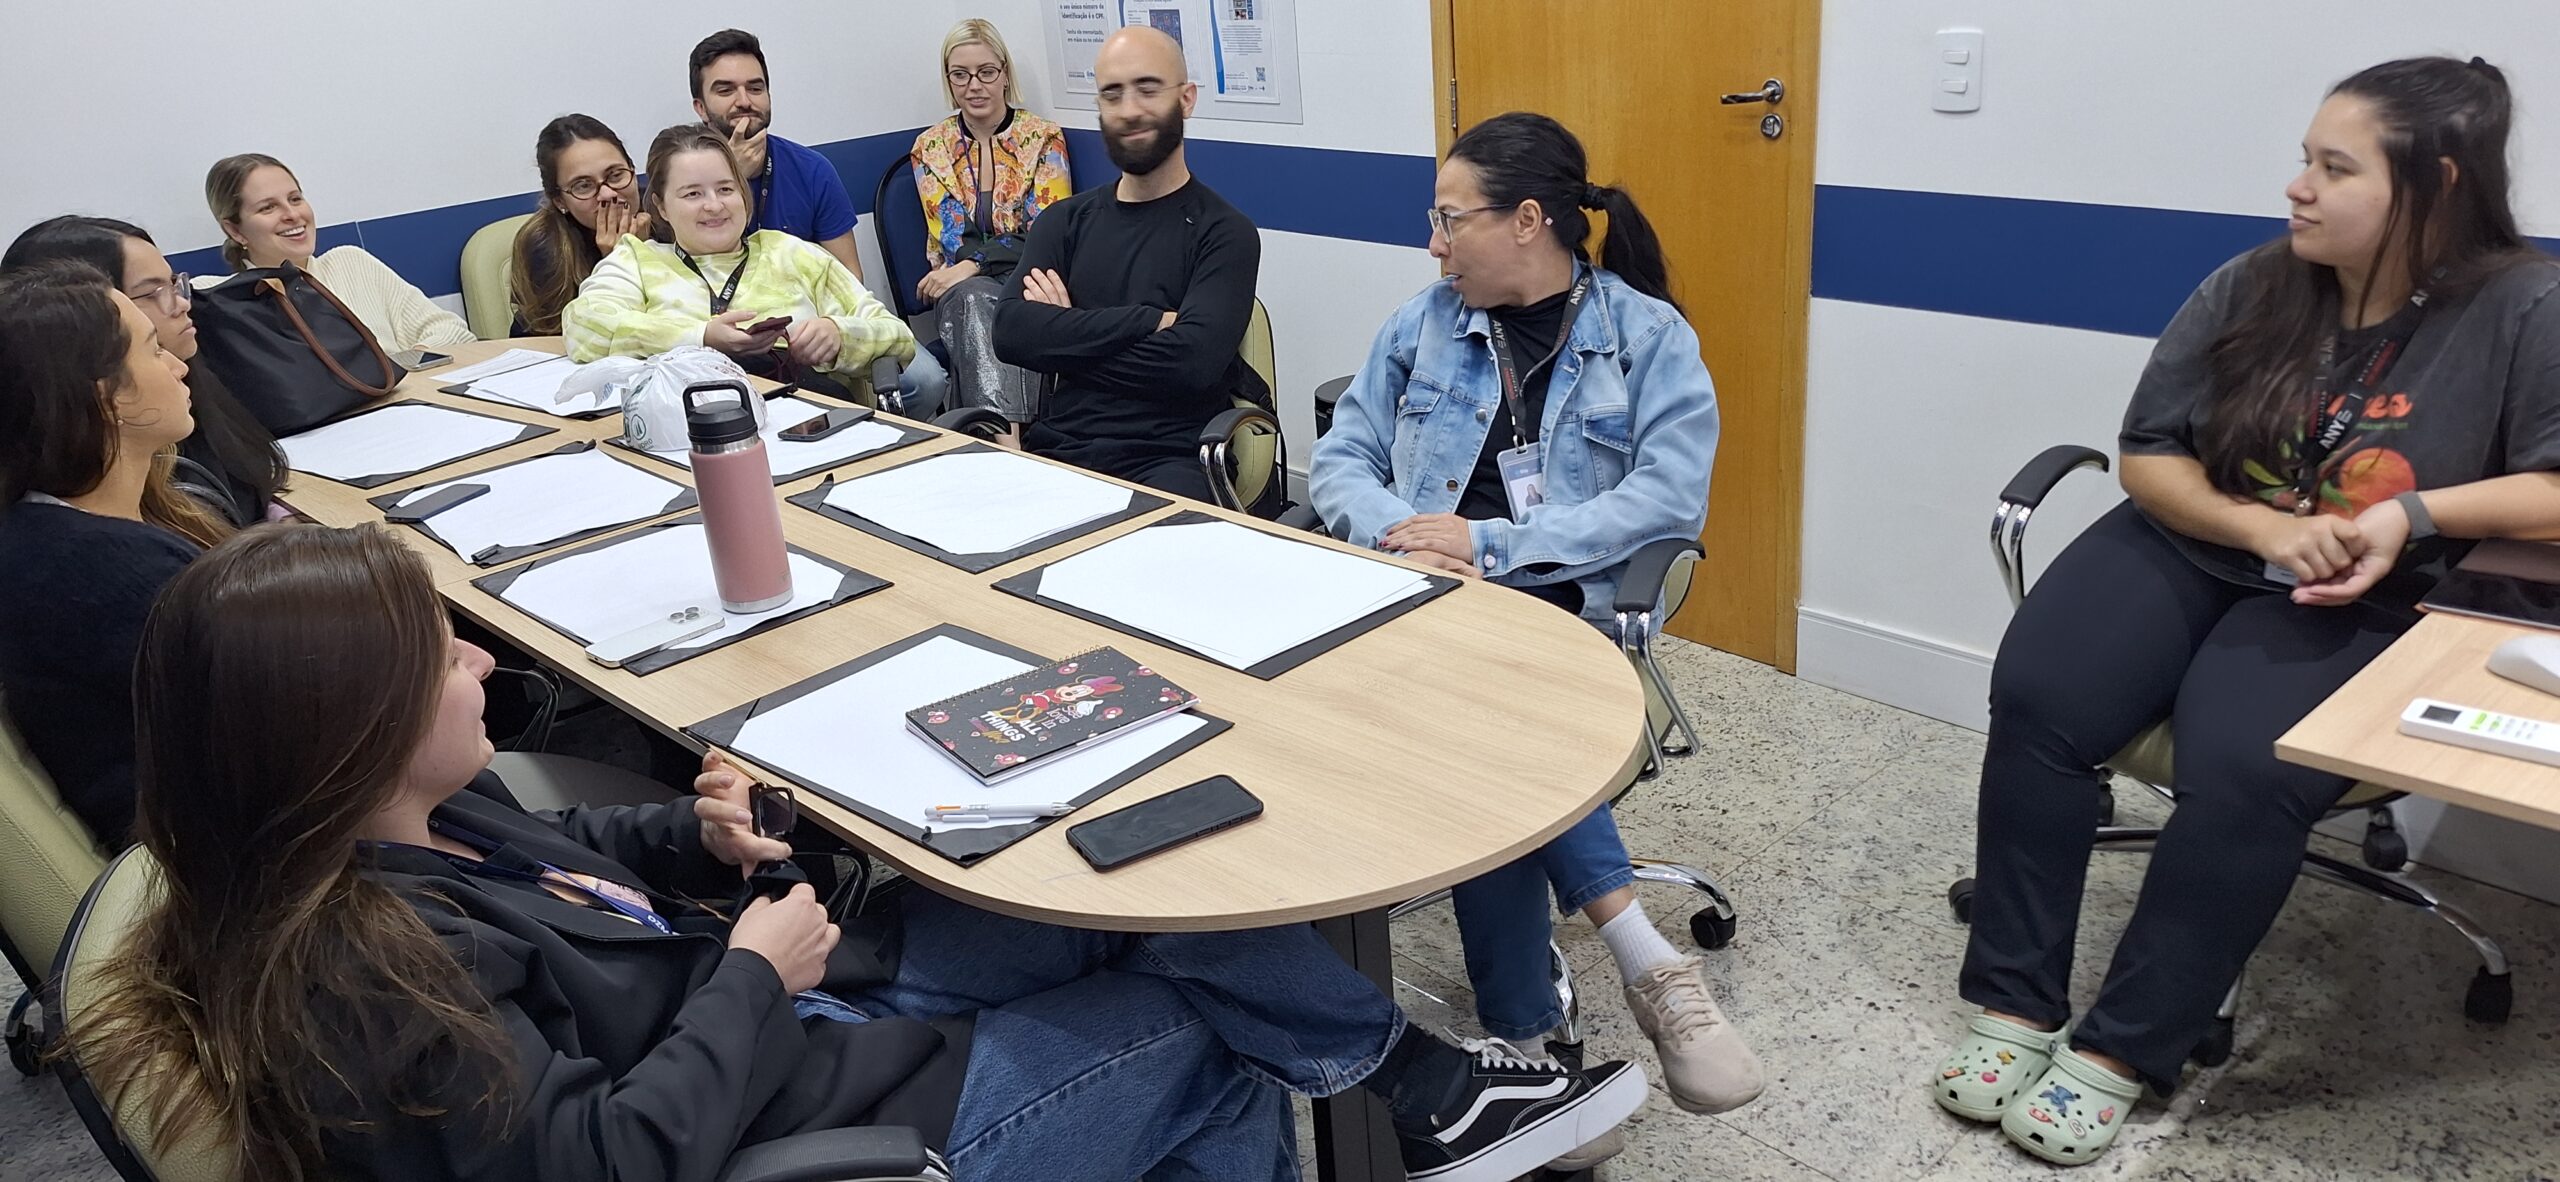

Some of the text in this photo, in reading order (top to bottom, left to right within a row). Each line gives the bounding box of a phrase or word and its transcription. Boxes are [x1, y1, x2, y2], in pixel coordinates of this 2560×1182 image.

[1061, 12, 1088, 20] identificação
[980, 710, 1026, 742] THINGS
[1015, 719, 1043, 736] ALL
